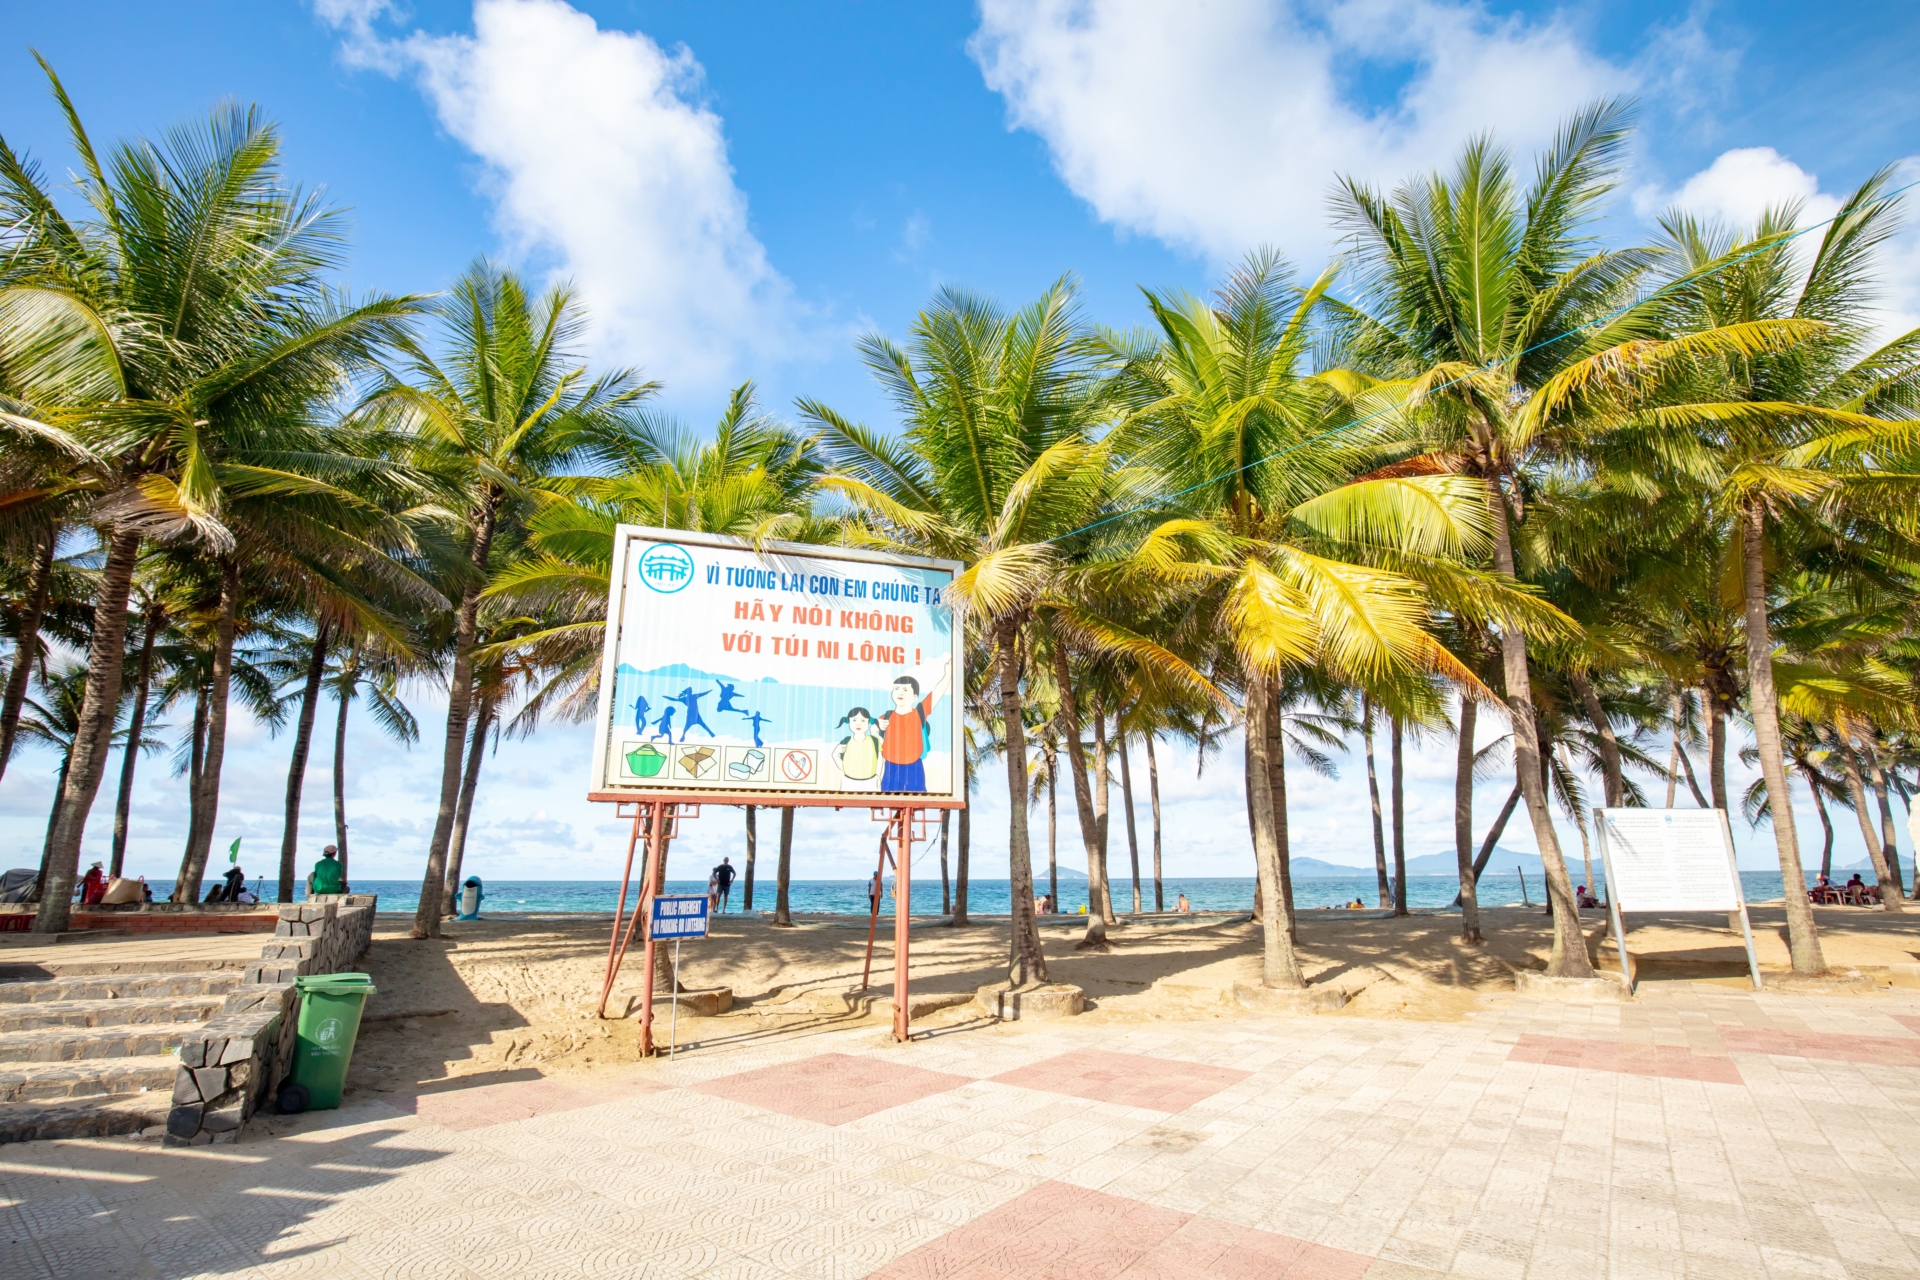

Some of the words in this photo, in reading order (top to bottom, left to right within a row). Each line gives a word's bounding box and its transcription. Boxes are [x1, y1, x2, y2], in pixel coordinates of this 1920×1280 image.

[706, 561, 720, 585] VÌ
[725, 565, 777, 590] TƯƠNG
[781, 572, 805, 593] LAI
[809, 575, 839, 596] CON
[844, 578, 867, 598] EM
[872, 579, 919, 604] CHÚNG
[924, 586, 941, 605] TA
[734, 598, 783, 623] HÃY
[792, 603, 832, 627] NÓI
[840, 609, 914, 634] KHÔNG
[722, 630, 762, 654] VỚI
[771, 634, 809, 657] TÚI
[817, 640, 839, 660] NI
[847, 640, 905, 665] LÔNG
[915, 648, 921, 666] !
[660, 901, 678, 916] PUBLIC
[678, 900, 702, 915] PAVEMENT
[653, 919, 660, 935] NO
[660, 918, 678, 934] PARKING
[678, 918, 685, 933] OR
